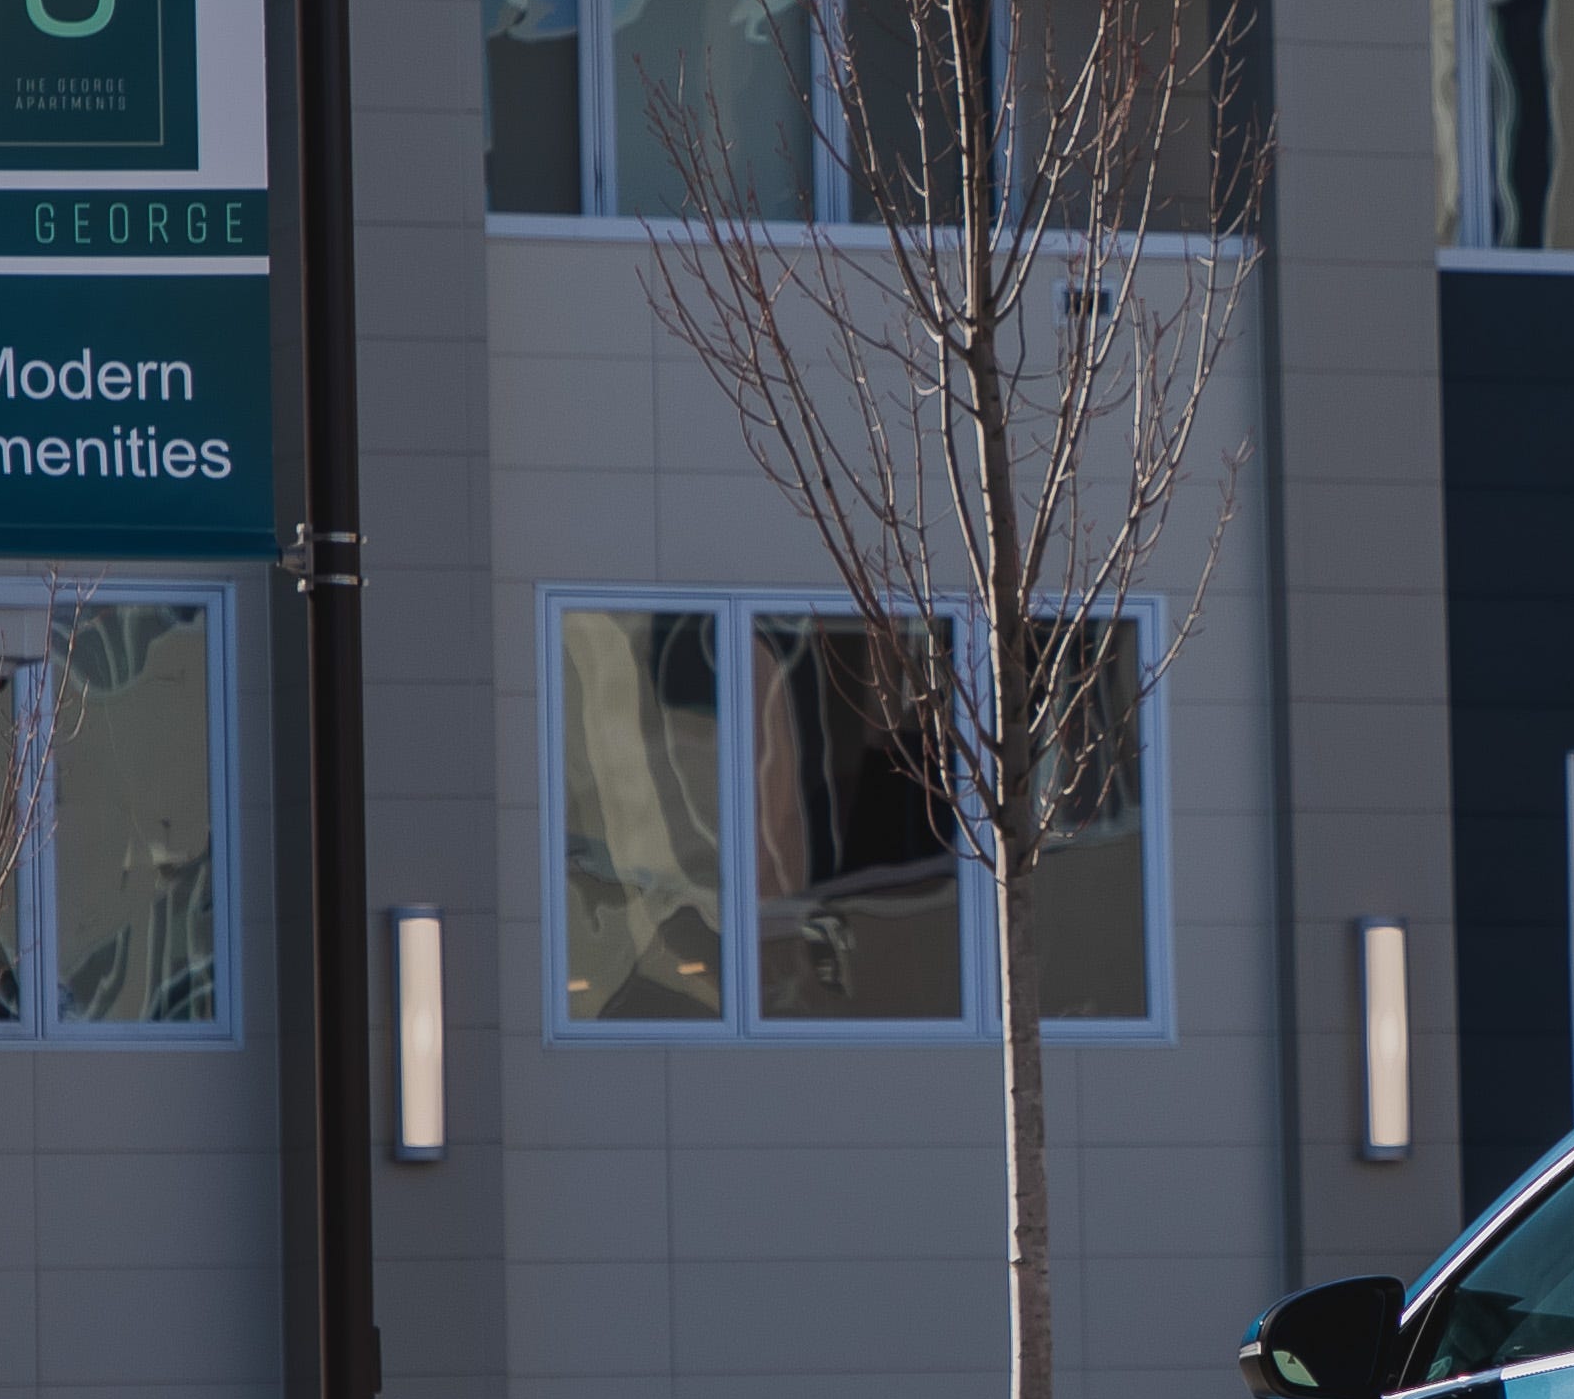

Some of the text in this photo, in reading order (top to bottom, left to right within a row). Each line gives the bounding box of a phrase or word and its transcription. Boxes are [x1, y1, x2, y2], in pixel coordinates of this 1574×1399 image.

[15, 77, 126, 94] THE GEORGE
[14, 95, 127, 112] APARTMENTS
[35, 202, 244, 244] GEORGE
